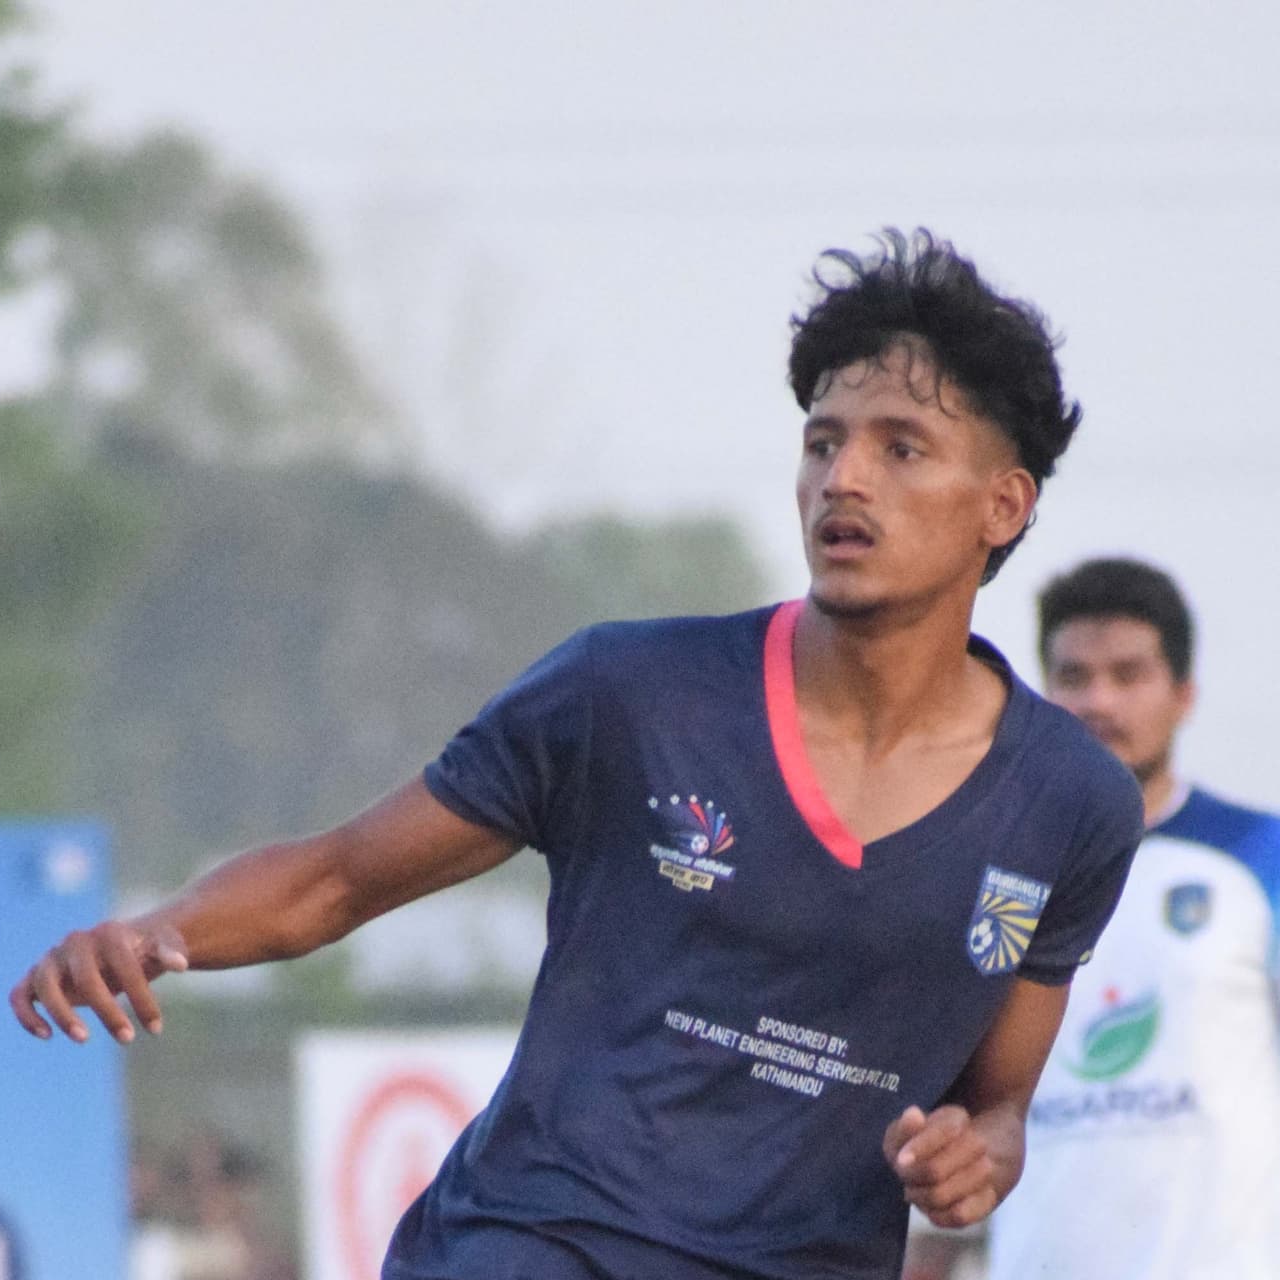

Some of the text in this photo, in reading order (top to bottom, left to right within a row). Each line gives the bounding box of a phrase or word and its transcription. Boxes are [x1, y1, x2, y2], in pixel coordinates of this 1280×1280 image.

[664, 1009, 695, 1033] NEW
[692, 1018, 741, 1049] PLANET
[737, 1034, 817, 1071] ENGINEERING
[815, 1056, 868, 1086] SERVICES
[879, 1072, 901, 1093] LTD.
[756, 1015, 849, 1058] SPONSORED BY:
[750, 1062, 825, 1098] KATHMANDU
